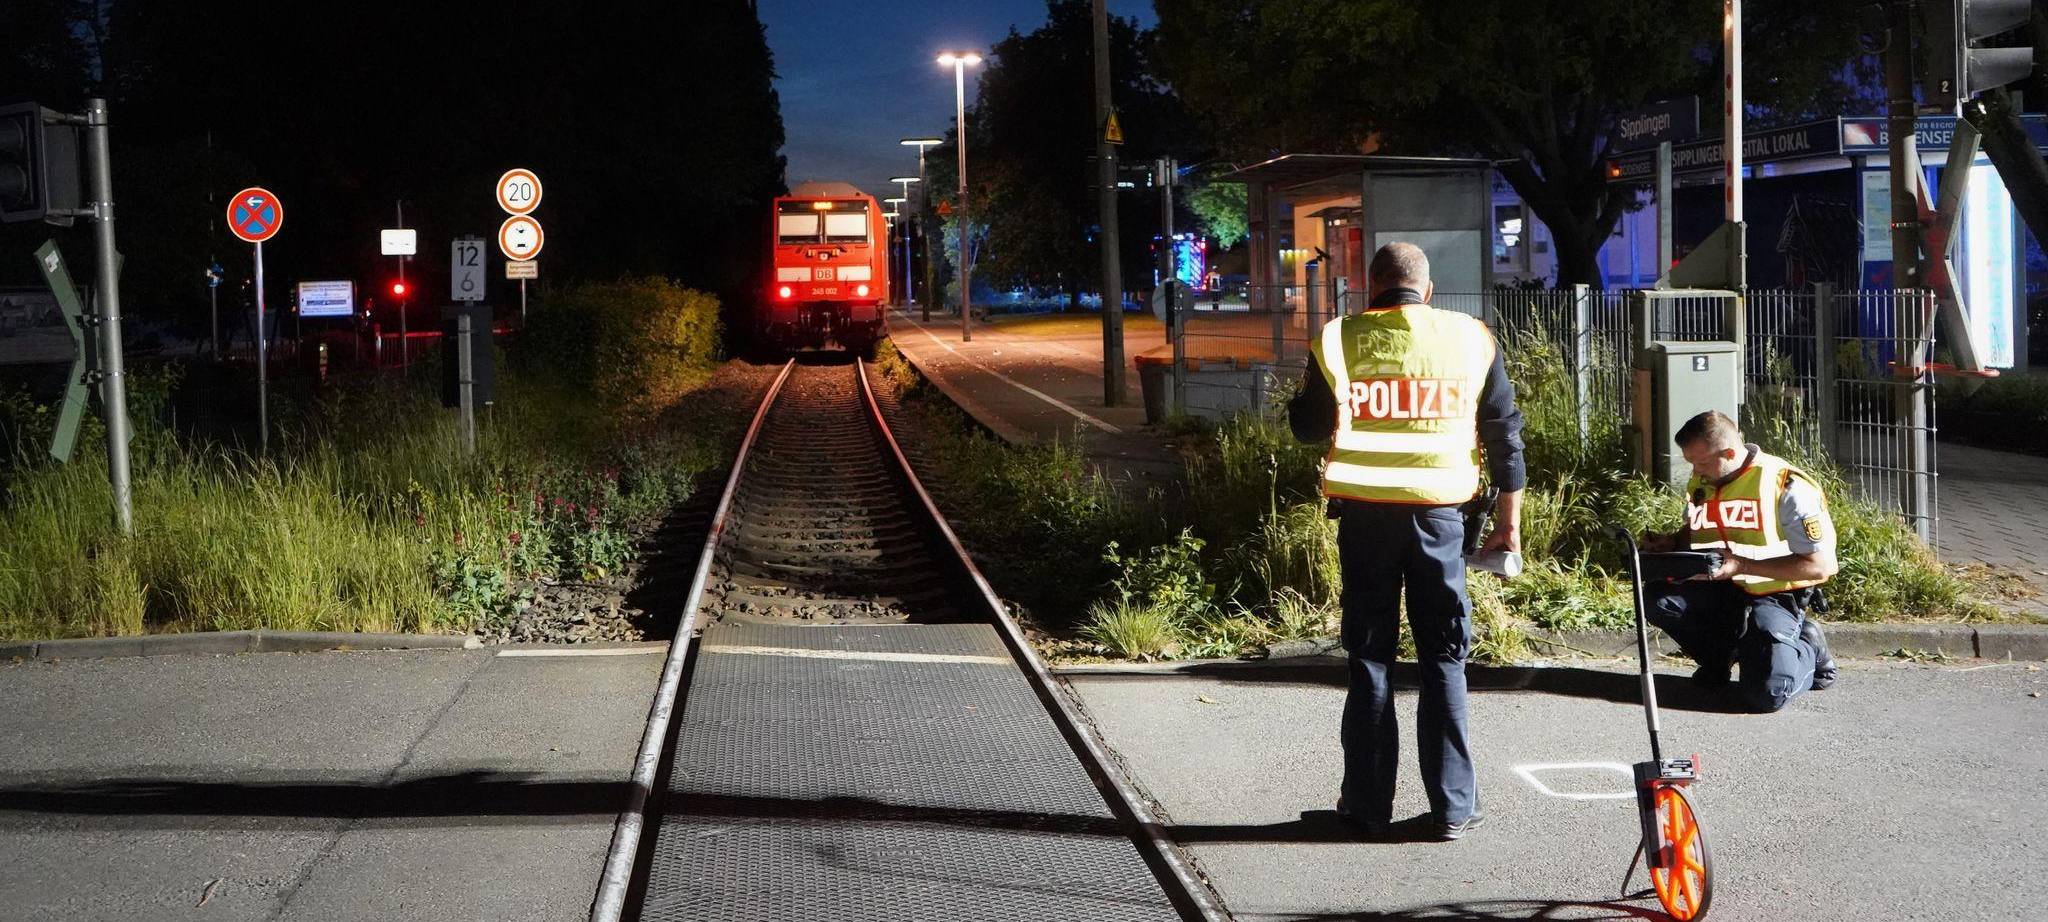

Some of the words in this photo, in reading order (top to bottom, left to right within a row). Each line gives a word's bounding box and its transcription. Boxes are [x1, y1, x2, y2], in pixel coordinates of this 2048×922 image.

[1941, 80, 1949, 93] 2
[1620, 112, 1671, 141] Sipplingen
[1772, 130, 1811, 154] LOKAL
[1879, 130, 1955, 146] BENSE
[509, 183, 531, 201] 20
[457, 245, 479, 267] 12
[461, 271, 474, 292] 6
[817, 270, 831, 278] DB
[1696, 357, 1706, 370] 2
[1350, 379, 1467, 419] POLIZEI
